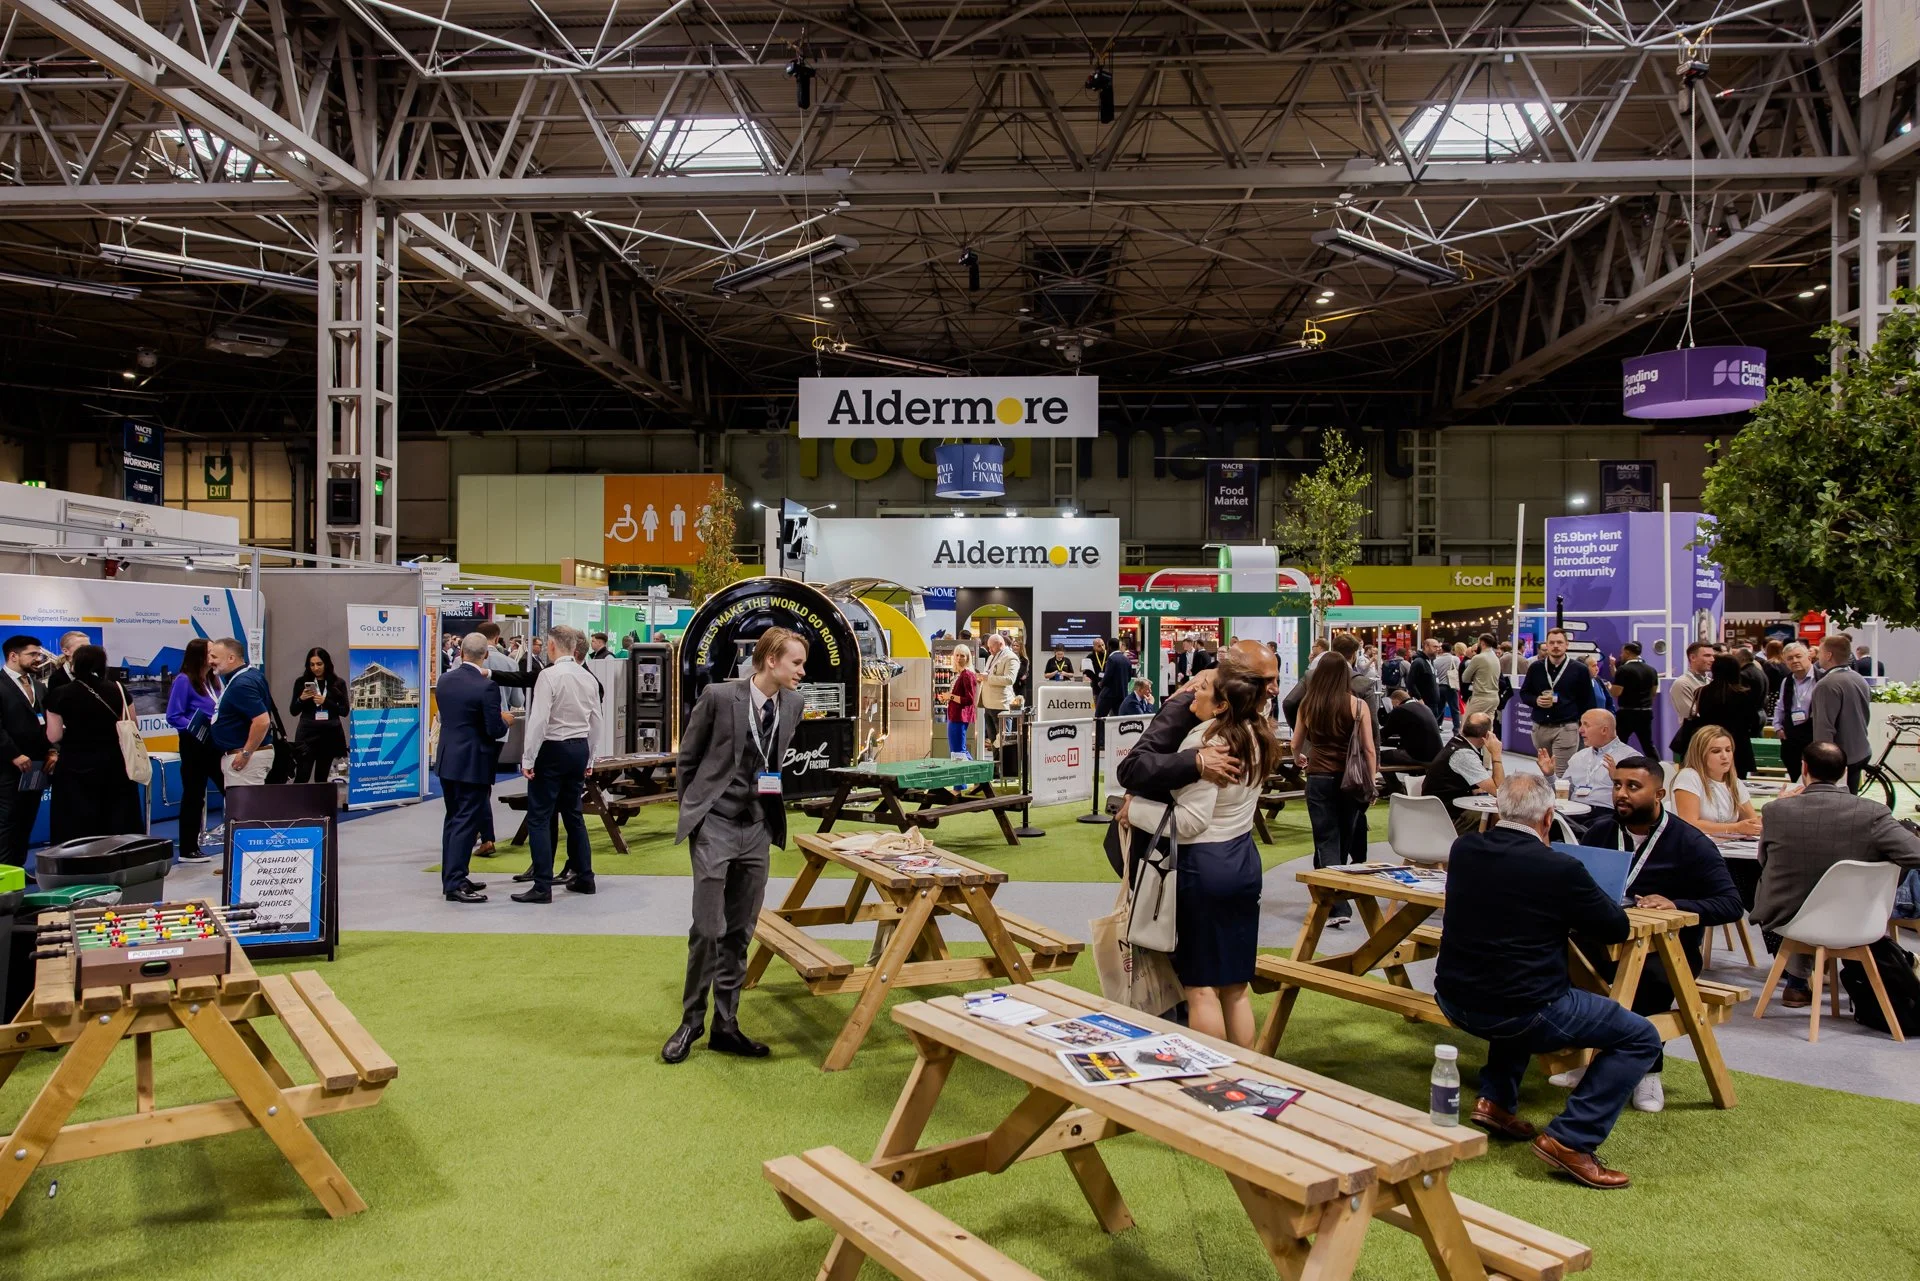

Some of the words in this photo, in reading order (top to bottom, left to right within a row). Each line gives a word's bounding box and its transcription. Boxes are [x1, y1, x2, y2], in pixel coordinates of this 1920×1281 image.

[827, 389, 1069, 425] Aldermore
[124, 456, 160, 471] WORKSPACE
[210, 485, 227, 497] EXIT
[1220, 486, 1244, 495] Food
[1214, 496, 1249, 506] Market
[1554, 531, 1598, 543] £5.9bn+
[1600, 530, 1622, 540] lent
[933, 539, 1099, 566] Aldermore
[1553, 542, 1597, 555] through
[1599, 544, 1619, 552] our
[1553, 555, 1611, 566] introducer
[1553, 566, 1616, 578] community
[1454, 571, 1494, 586] food
[1134, 598, 1180, 610] octane
[23, 615, 58, 623] Development
[696, 625, 719, 665] BAGELS
[716, 603, 745, 627] MAKE
[746, 597, 768, 609] THE
[770, 597, 809, 617] WORLD
[808, 613, 823, 629] GO
[819, 626, 841, 667] ROUND
[1049, 728, 1065, 738] Central
[1064, 726, 1075, 736] Park
[1133, 721, 1143, 731] Park
[782, 742, 830, 776] Bagel
[809, 760, 830, 770] FACTORY
[1045, 754, 1066, 764] iwoca
[257, 856, 299, 864] CASHFLOW
[257, 867, 297, 875] PRESSURE
